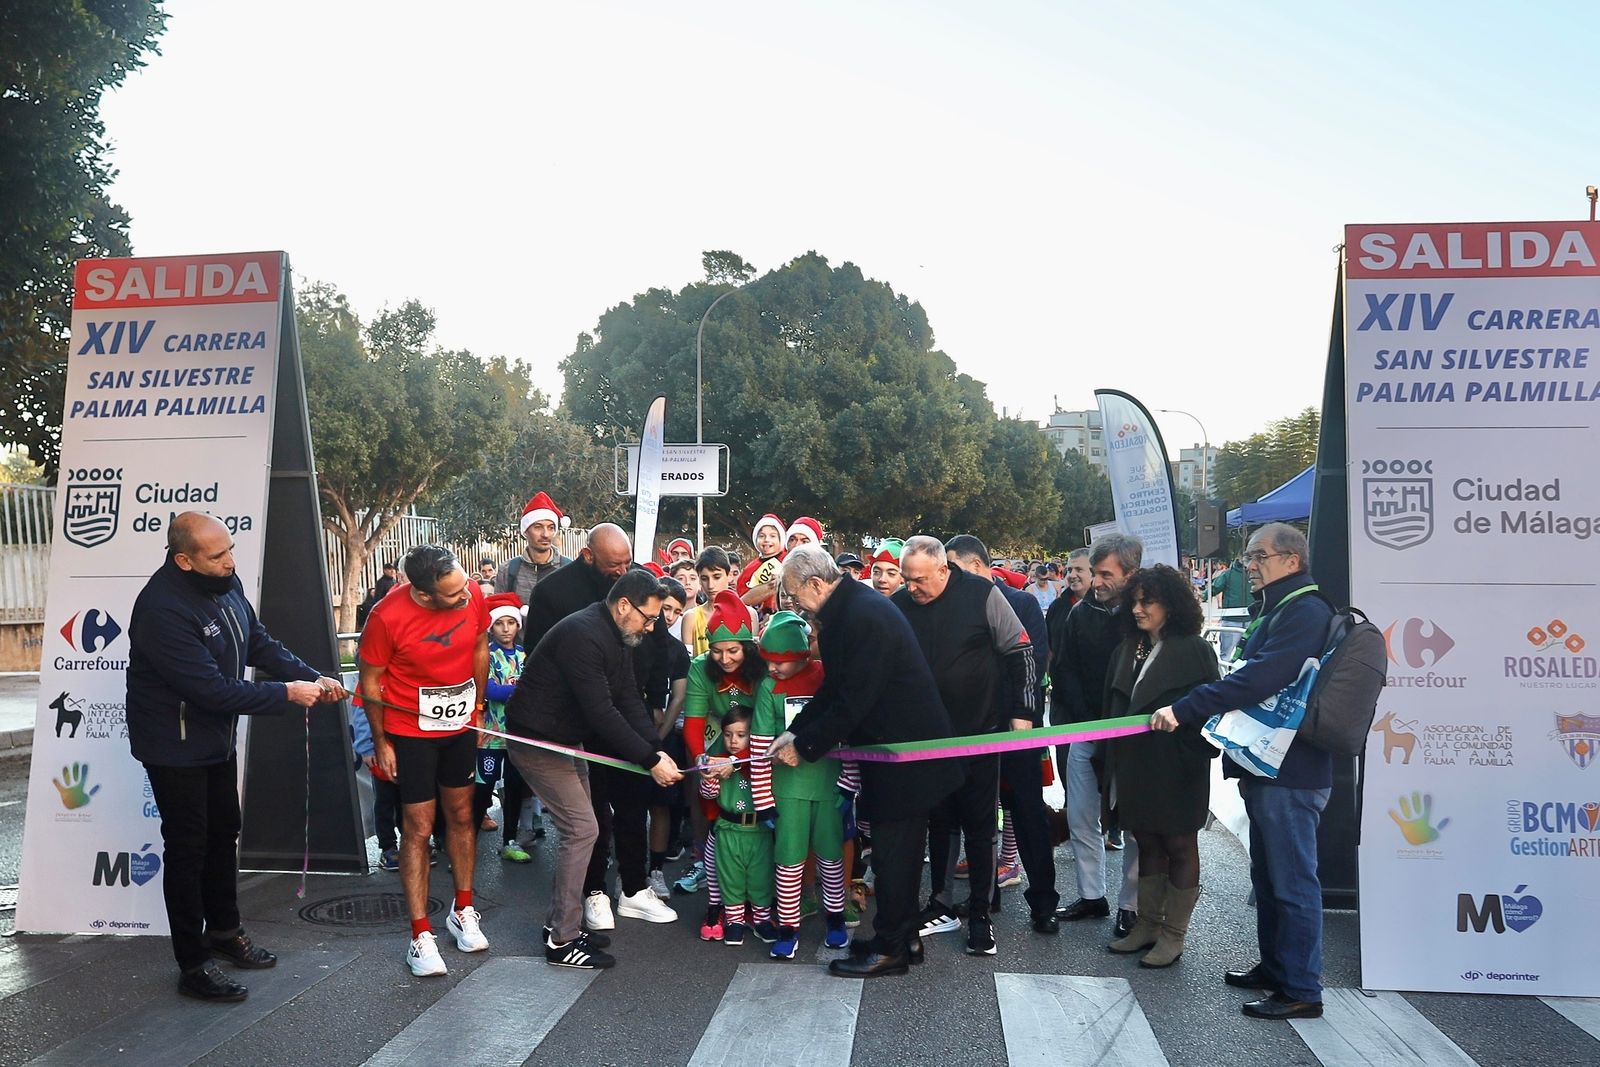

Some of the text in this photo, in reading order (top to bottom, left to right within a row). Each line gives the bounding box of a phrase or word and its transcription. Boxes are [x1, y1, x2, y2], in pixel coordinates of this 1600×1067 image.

[1358, 230, 1597, 270] SALIDA
[84, 262, 268, 301] SALIDA
[1356, 292, 1600, 331] XIV CARRERA
[77, 320, 266, 355] XIV CARRERA
[1374, 348, 1589, 370] SAN SILVESTRE
[87, 366, 255, 389] SAN SILVESTRE
[1356, 382, 1455, 402] PALMA
[69, 395, 265, 419] PALMA PALMILLA
[661, 472, 704, 480] ERADOS
[135, 482, 219, 504] Ciudad
[1452, 477, 1561, 502] Ciudad
[132, 512, 161, 532] de
[1453, 510, 1491, 535] de
[54, 656, 127, 670] Carrefour
[1504, 656, 1600, 678] ROSALED
[1386, 671, 1467, 688] arrefour
[432, 701, 467, 719] 962
[705, 724, 716, 740] 09
[1423, 741, 1513, 750] A LA COMUNIDAD
[1423, 757, 1513, 766] PALMA PALMILLA
[1507, 800, 1521, 833] GRUPO
[1523, 802, 1576, 833] BCM
[1510, 837, 1600, 857] GestionART
[109, 921, 150, 929] deporinter
[1486, 972, 1540, 981] deporinter
